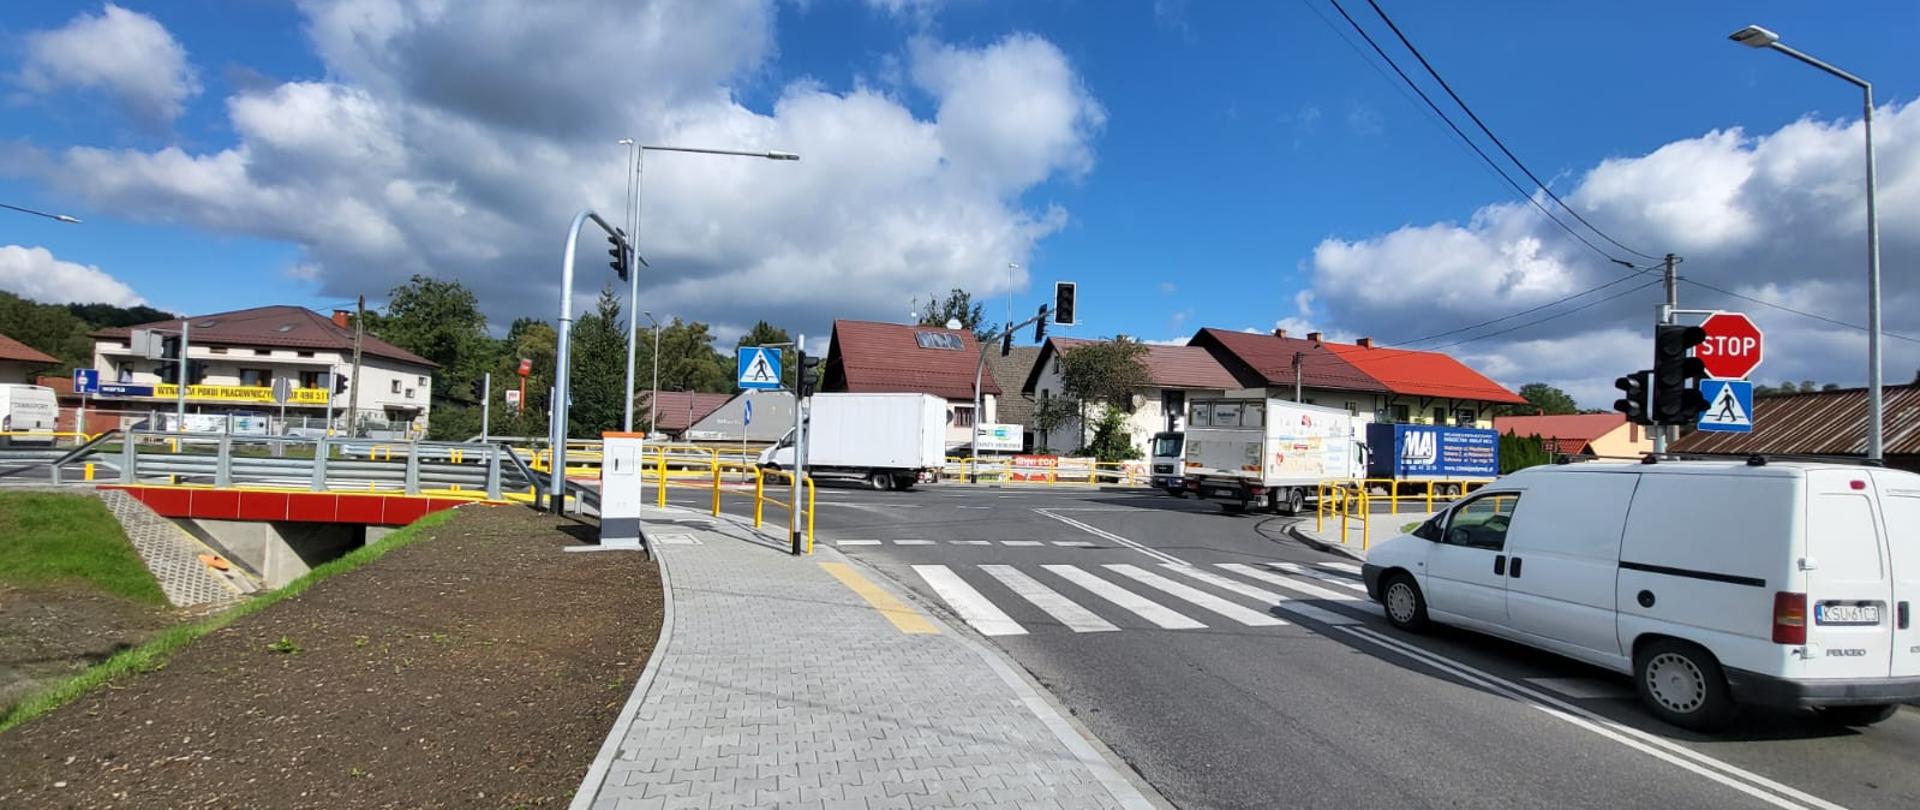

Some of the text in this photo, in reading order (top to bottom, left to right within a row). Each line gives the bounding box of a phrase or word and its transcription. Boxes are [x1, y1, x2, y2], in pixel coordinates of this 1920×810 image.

[1702, 336, 1756, 356] STOP
[157, 386, 195, 396] WYNM
[1402, 431, 1437, 464] MAJ
